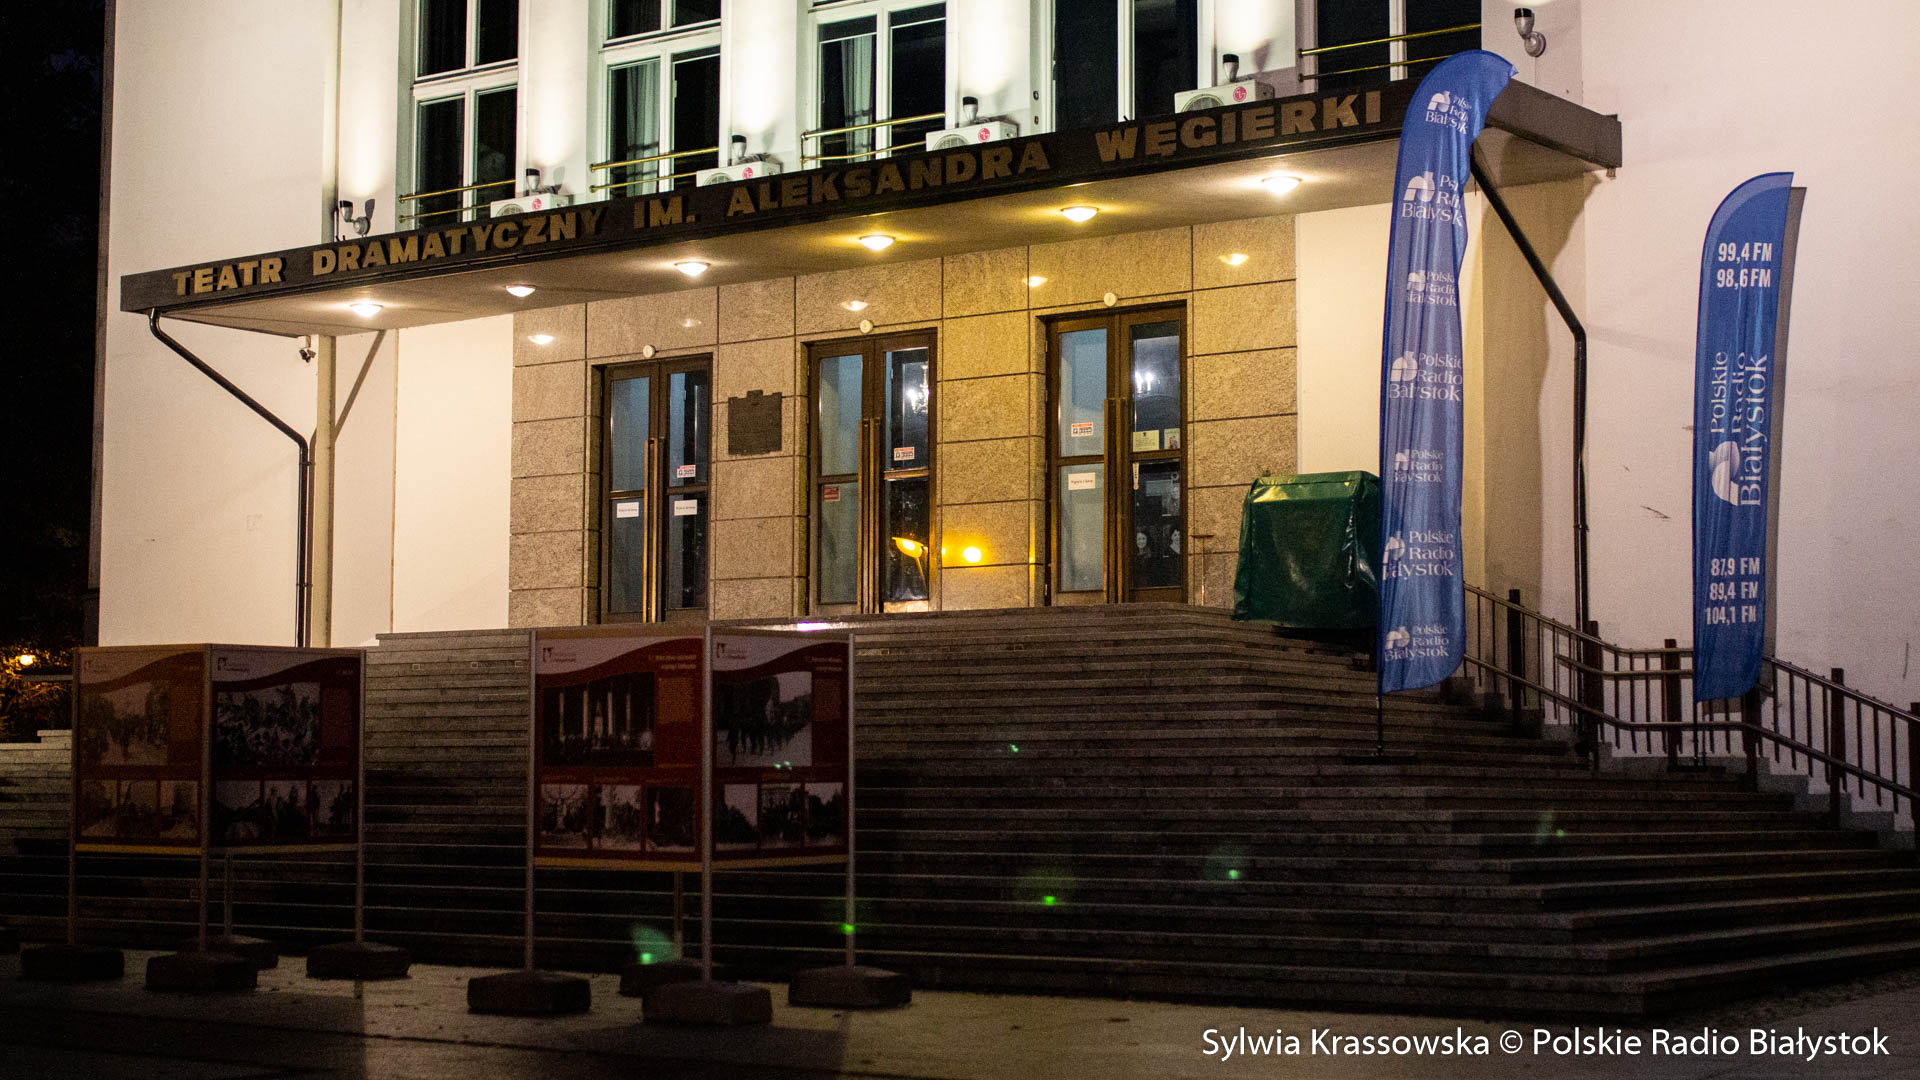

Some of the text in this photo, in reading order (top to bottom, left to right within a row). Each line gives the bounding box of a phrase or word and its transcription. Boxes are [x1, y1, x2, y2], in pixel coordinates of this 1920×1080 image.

[172, 91, 1381, 296] TEATR DRAMATYCZNY IM. ALEKSANDRA WĘGIERKI
[1718, 242, 1773, 264] 99,4 FM
[1716, 268, 1771, 290] 98,6 FM
[1417, 369, 1462, 385] Radio
[1711, 351, 1729, 433] Polskie
[1731, 352, 1745, 433] Radio
[1740, 353, 1768, 506] Białystok
[1711, 557, 1760, 577] 87,9 FM
[1709, 582, 1736, 602] 89,4
[1705, 606, 1736, 626] 104,1
[1412, 635, 1449, 646] Radio
